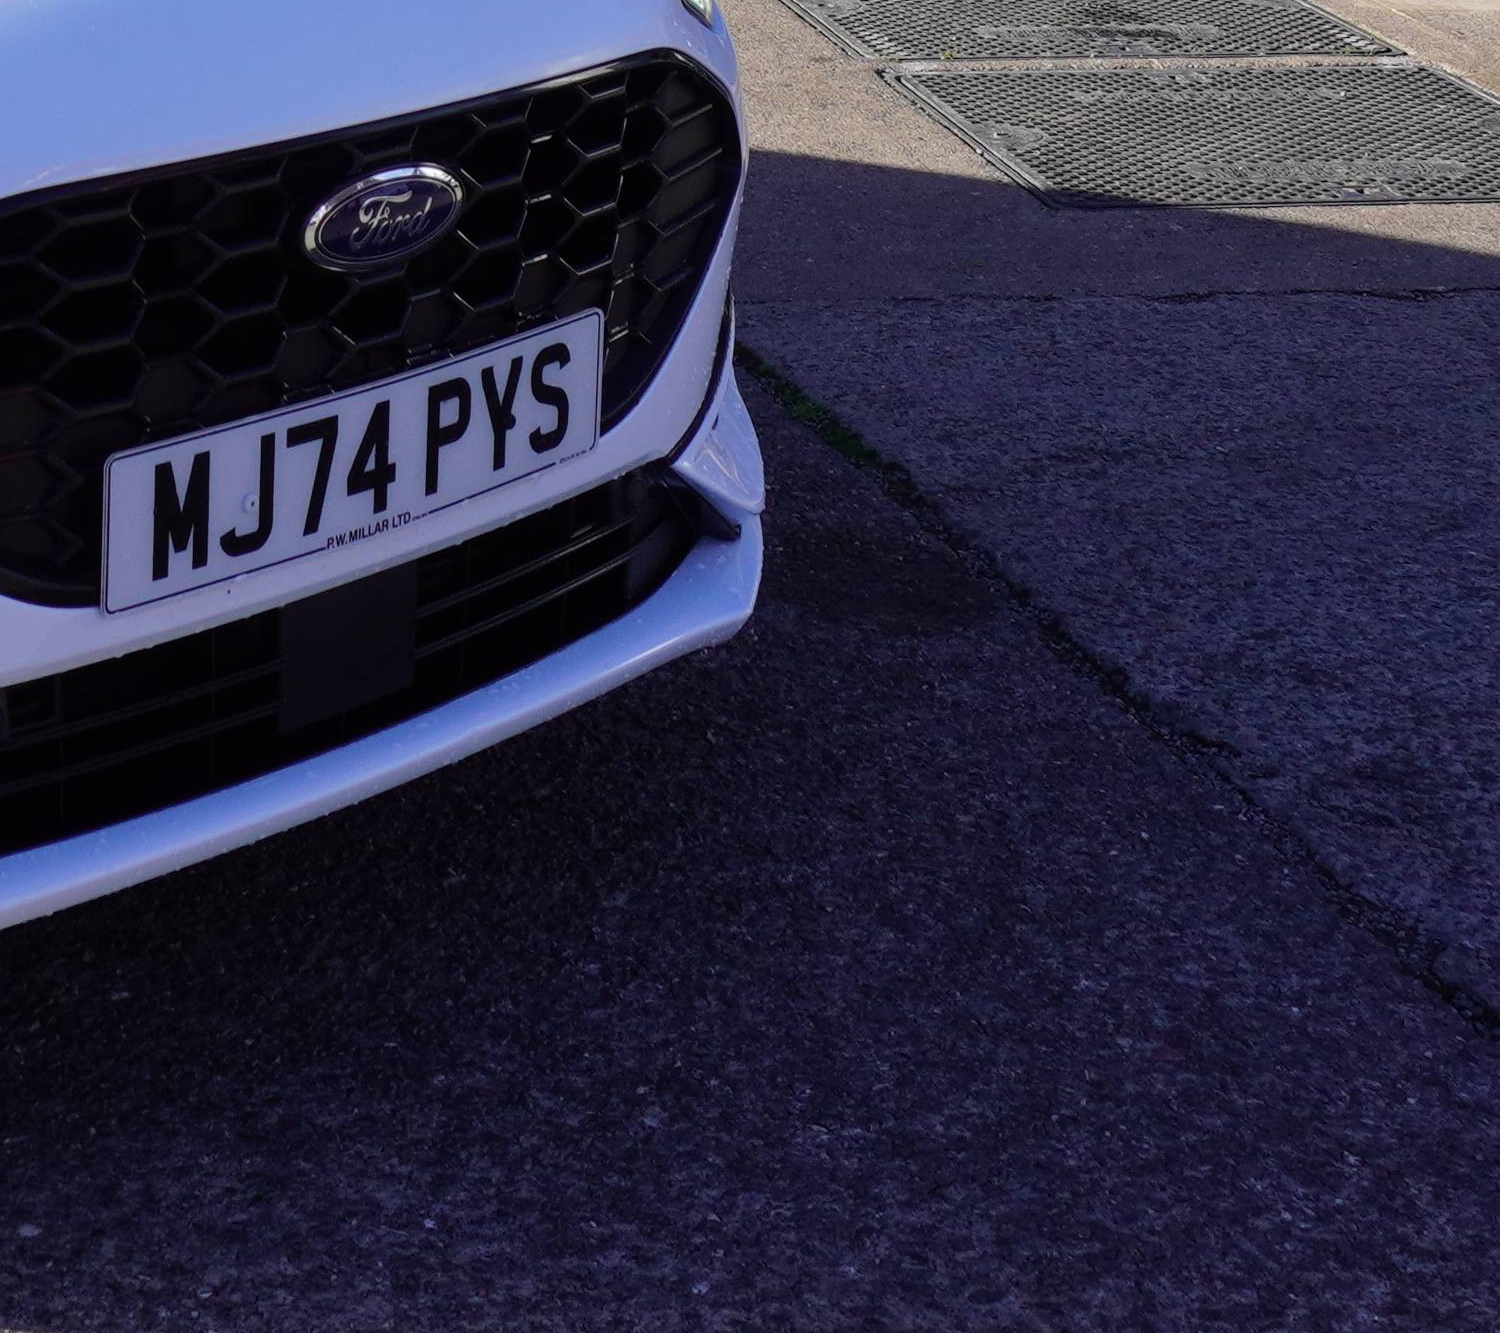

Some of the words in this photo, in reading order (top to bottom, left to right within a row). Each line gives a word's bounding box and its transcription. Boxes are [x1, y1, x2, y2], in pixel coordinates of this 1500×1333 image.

[151, 399, 397, 582] MJ74
[424, 342, 572, 497] PYS
[391, 511, 412, 527] LTD
